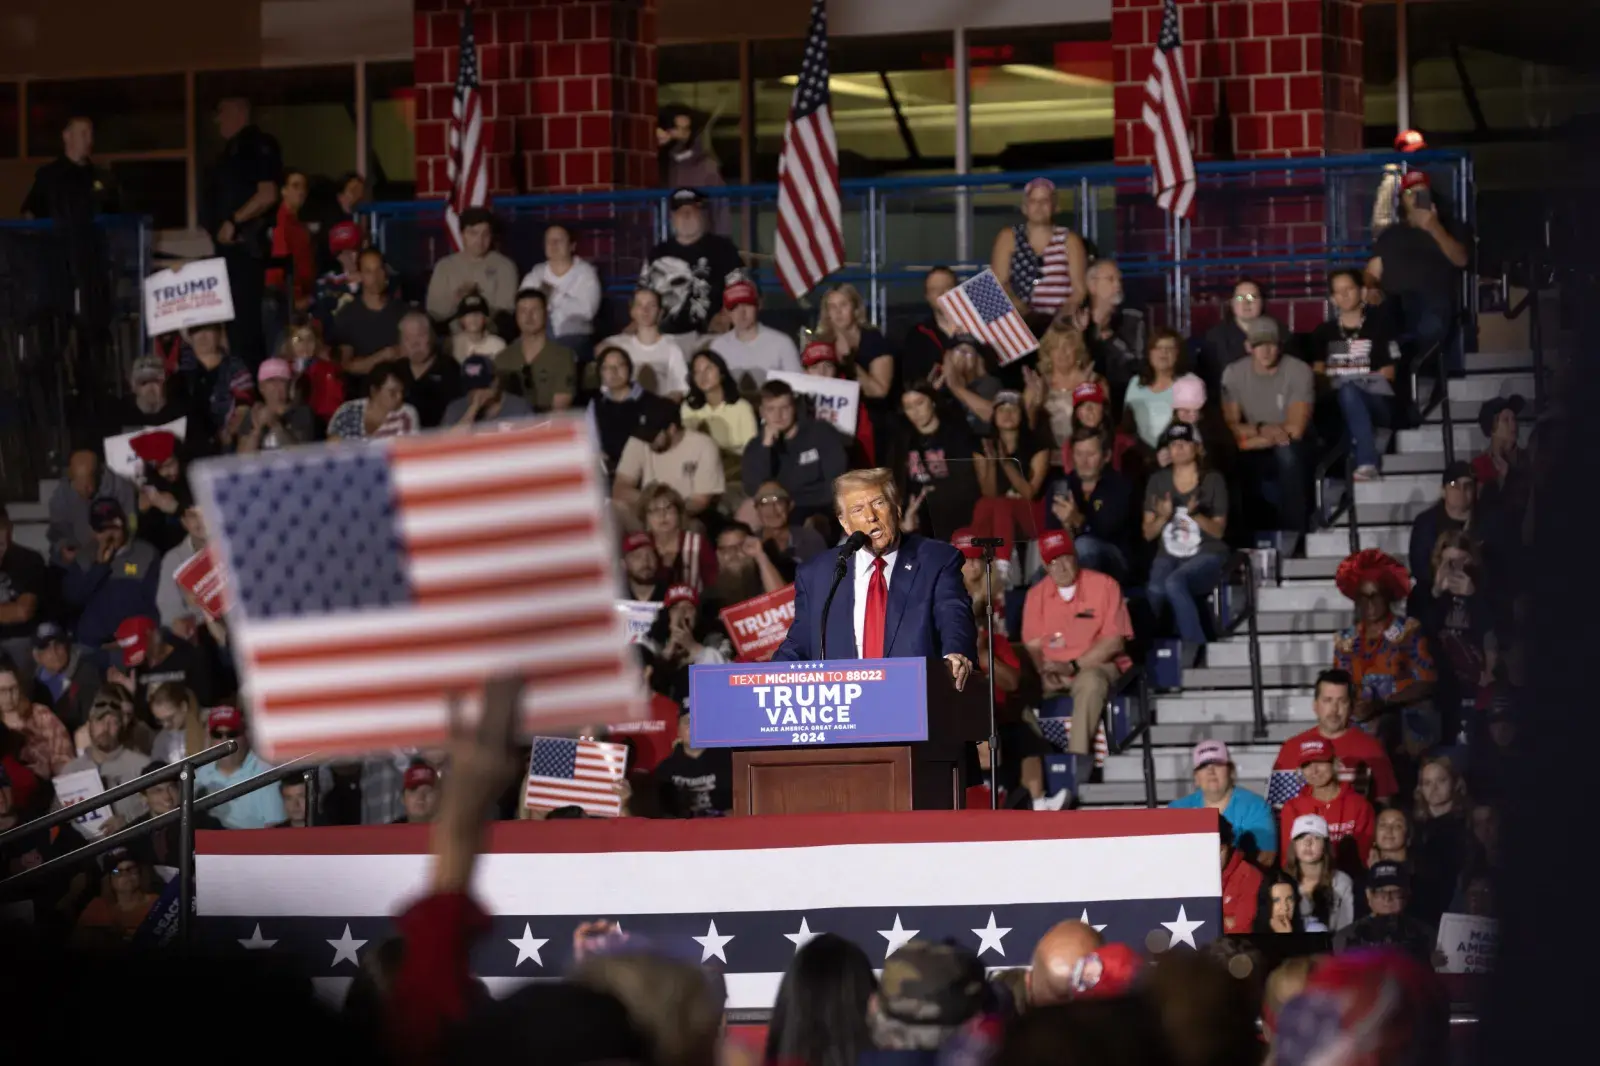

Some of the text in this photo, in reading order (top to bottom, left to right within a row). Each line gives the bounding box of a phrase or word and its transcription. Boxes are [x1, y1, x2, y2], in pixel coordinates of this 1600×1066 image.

[153, 277, 219, 302] TRUMP
[733, 670, 882, 685] TEXT MICHIGAN TO 88022
[753, 683, 862, 707] TRUMP
[765, 705, 850, 725] VANCE
[791, 732, 826, 743] 2024
